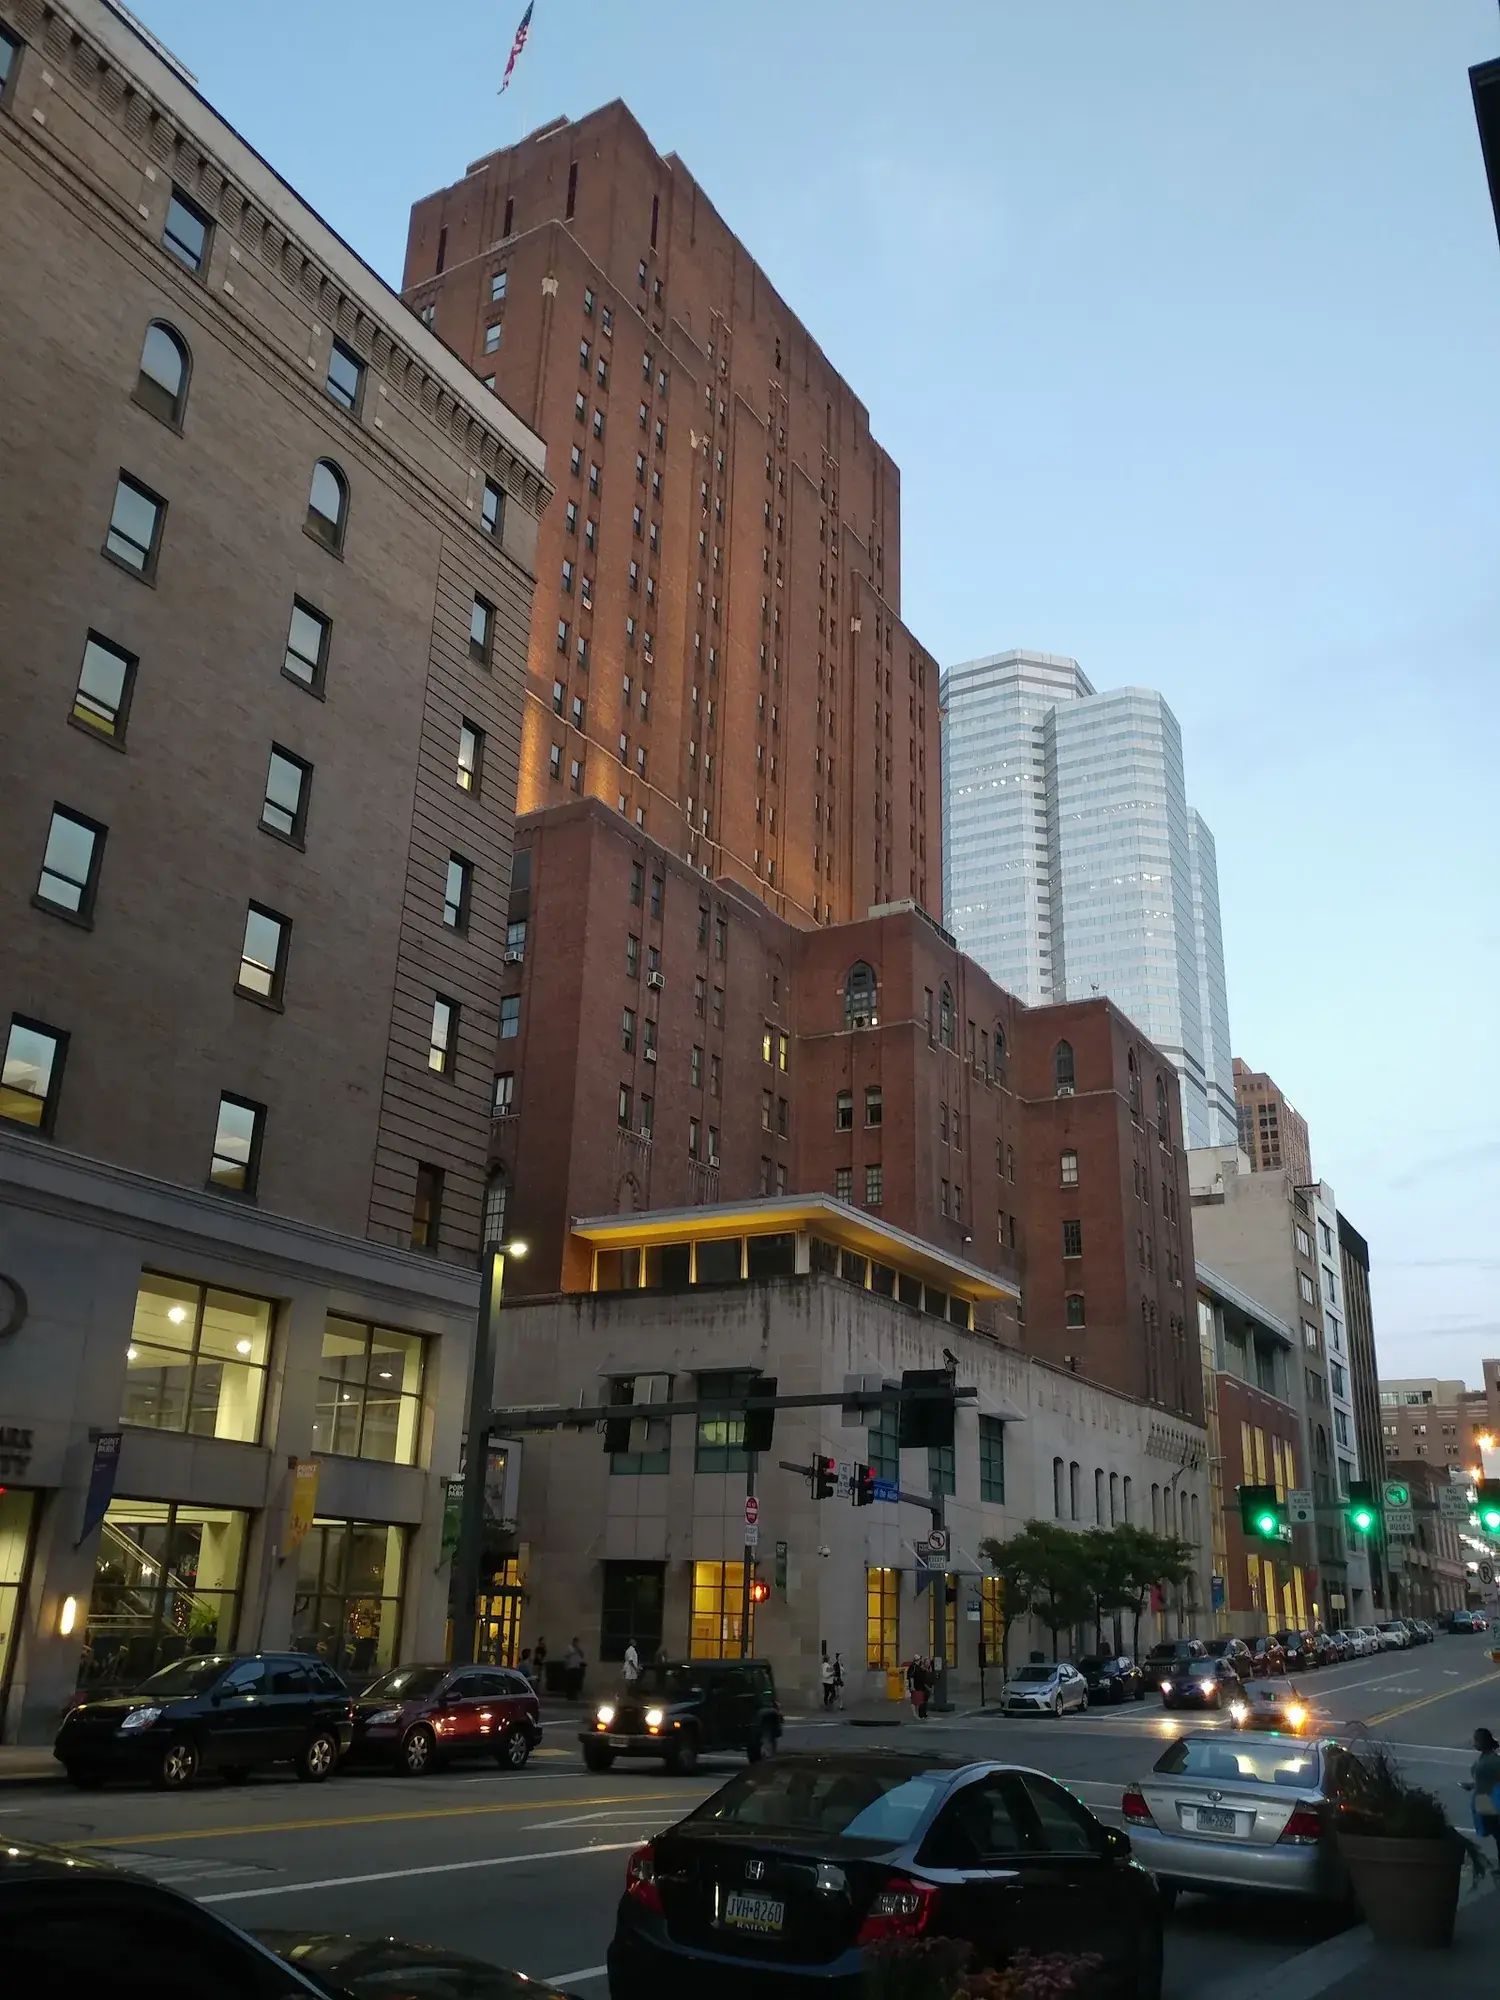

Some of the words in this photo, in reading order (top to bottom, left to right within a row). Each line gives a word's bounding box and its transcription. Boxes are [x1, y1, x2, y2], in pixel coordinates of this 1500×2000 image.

[99, 1437, 120, 1446] POINT
[97, 1445, 115, 1453] PARK
[297, 1464, 318, 1473] POINT
[447, 1490, 465, 1498] PARK
[1445, 1494, 1462, 1502] TURN
[1386, 1514, 1412, 1523] EXCEPT
[1389, 1523, 1411, 1531] BUSES
